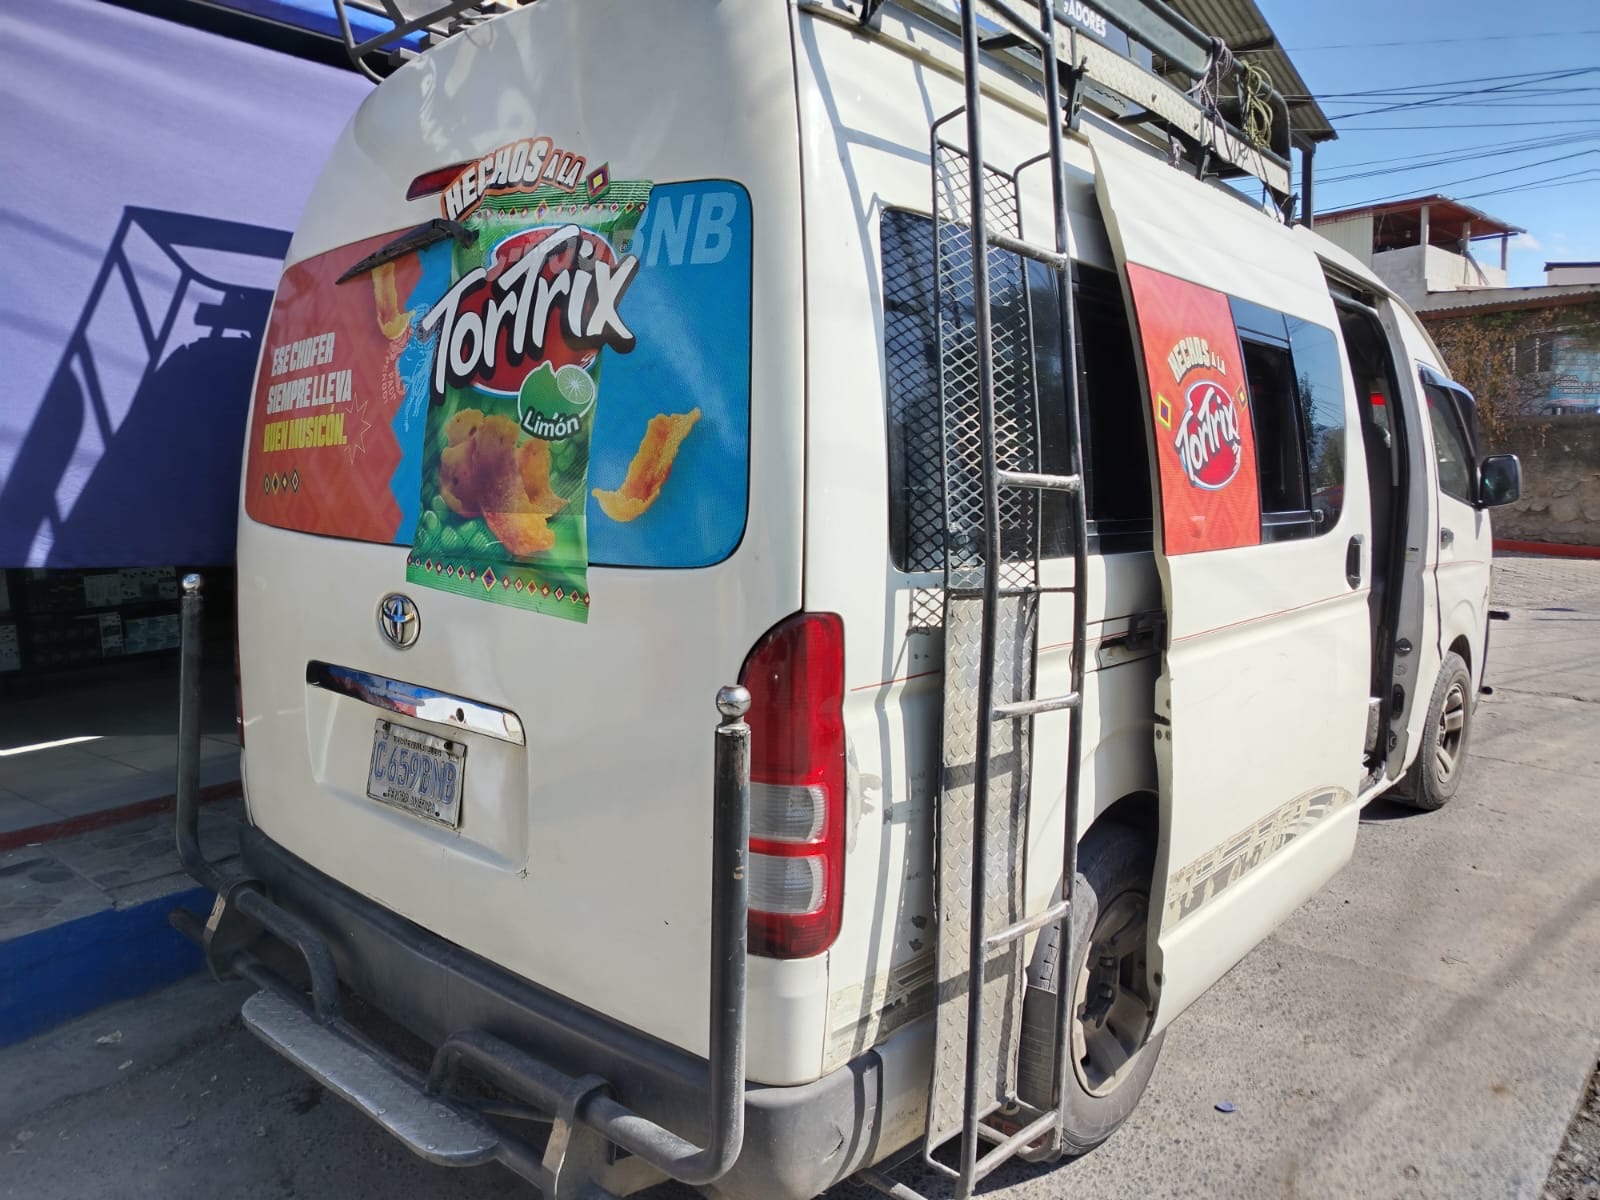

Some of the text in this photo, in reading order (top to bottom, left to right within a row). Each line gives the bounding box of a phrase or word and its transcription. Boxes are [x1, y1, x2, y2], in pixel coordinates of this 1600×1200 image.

[444, 139, 583, 220] HECHOS A LA
[418, 223, 639, 400] TorTrix
[271, 332, 336, 377] ESE CHOFER
[1168, 336, 1212, 384] HECHOS
[266, 376, 313, 415] SIEMPRE
[311, 369, 352, 407] LLEVA
[263, 403, 348, 453] BUEN MUSICÓN.
[522, 409, 580, 437] Limón
[1174, 385, 1241, 483] TorTrix
